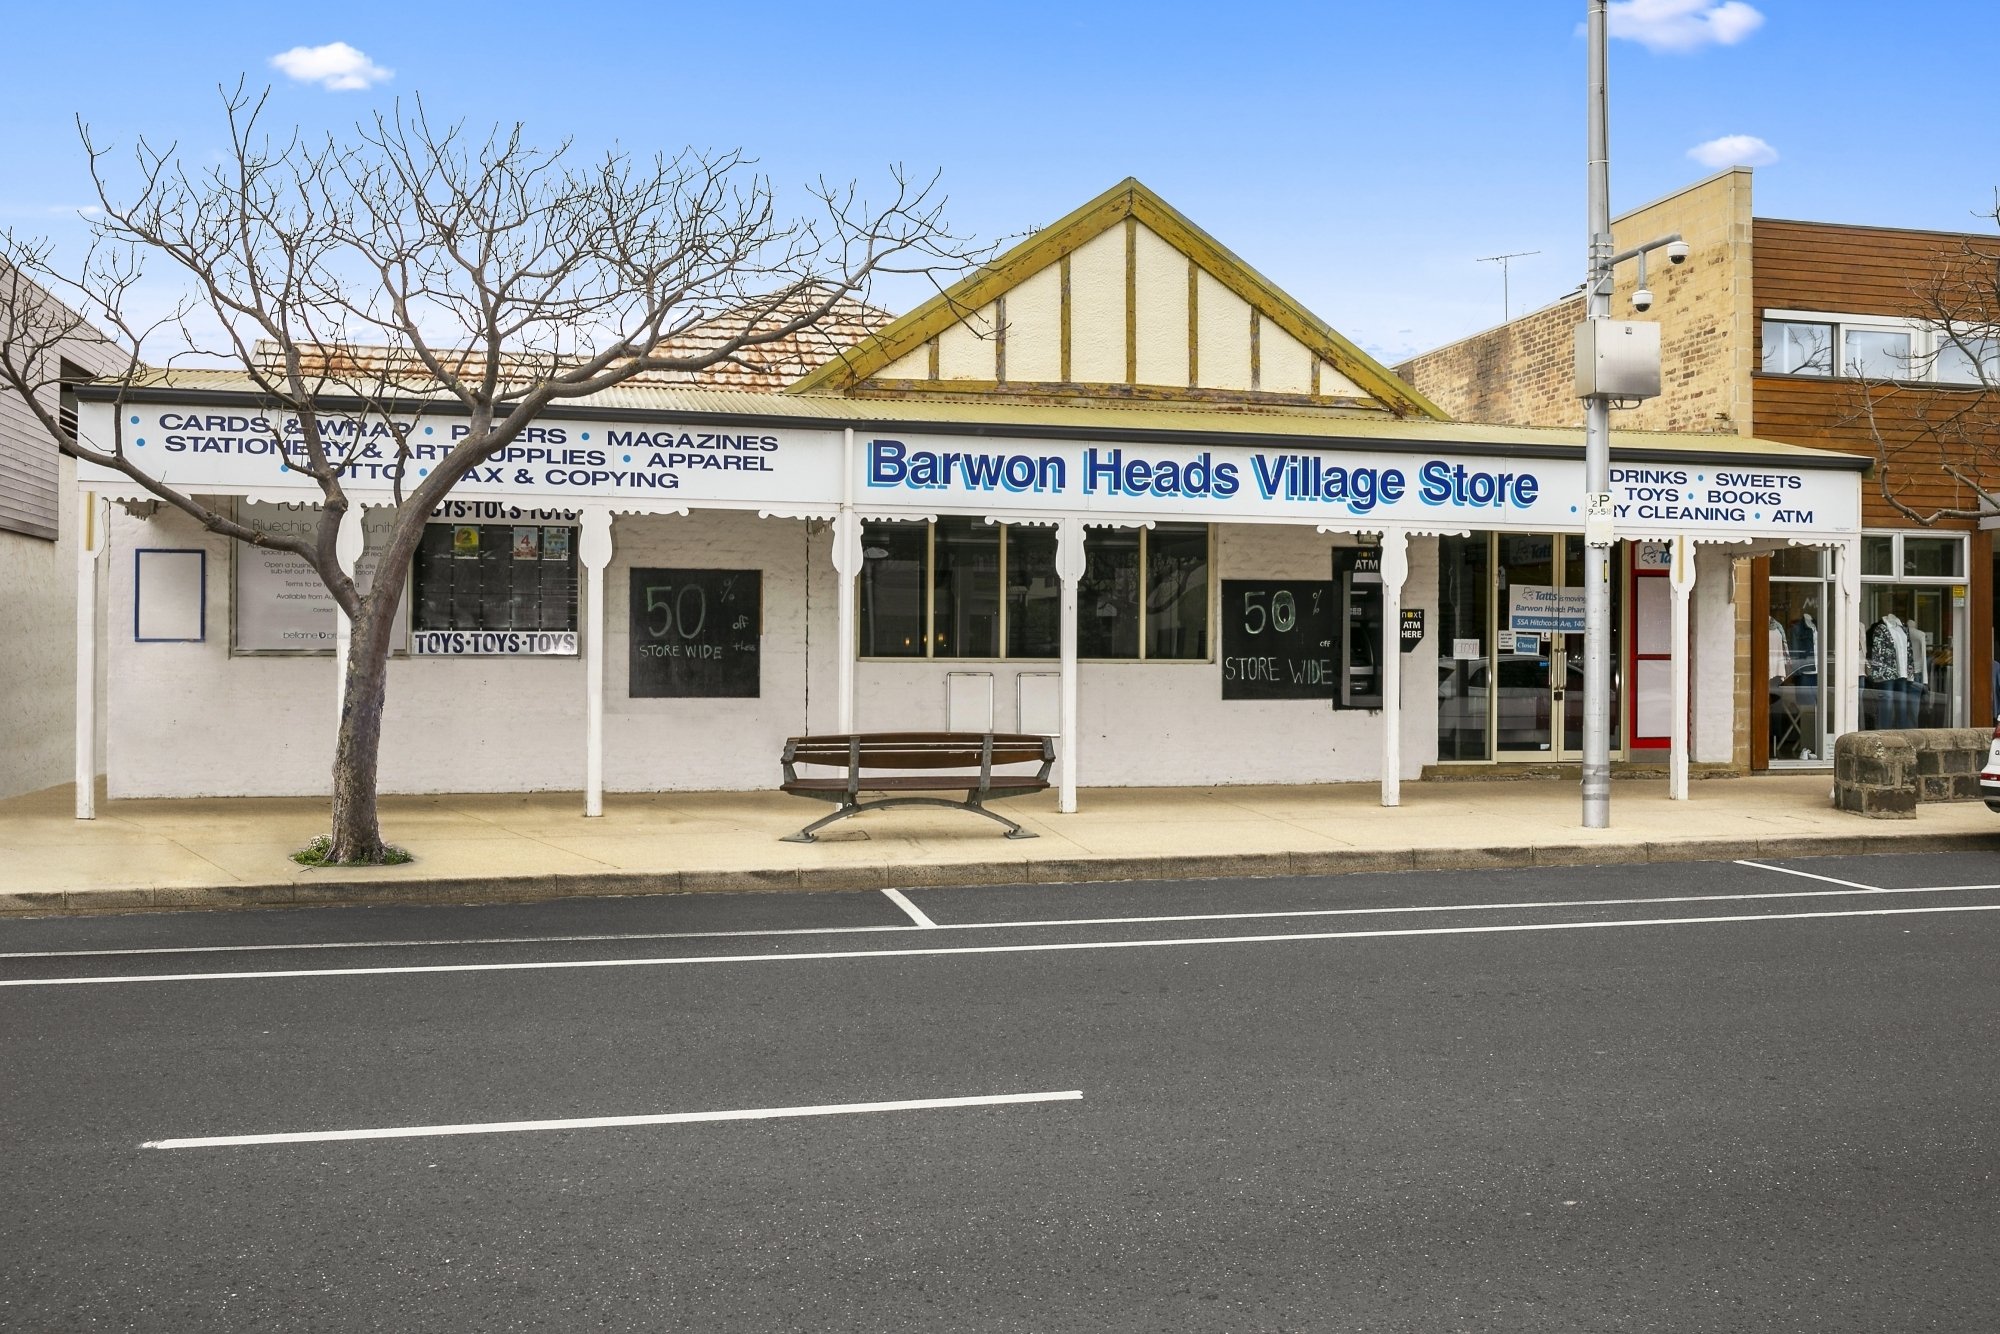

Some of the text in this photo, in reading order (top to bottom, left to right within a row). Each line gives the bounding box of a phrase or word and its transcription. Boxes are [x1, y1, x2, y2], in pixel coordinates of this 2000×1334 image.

[159, 413, 411, 438] CARDS & WRAP
[607, 430, 779, 451] MAGAZINES
[361, 442, 383, 458] &
[393, 443, 455, 461] ART
[486, 447, 606, 466] UPPLIES
[646, 452, 774, 471] APPAREL
[514, 468, 535, 484] &
[545, 469, 679, 489] COPYING
[867, 439, 1539, 515] Barwon Heads Village Store
[1609, 469, 1688, 485] DRINKS
[1715, 472, 1802, 489] SWEETS
[1625, 487, 1679, 502] TOYS
[1707, 490, 1782, 505] BOOKS
[1638, 505, 1746, 522] CLEANING
[1772, 509, 1814, 524] ATM
[252, 518, 312, 534] Bluechip
[1354, 559, 1379, 571] ATM
[1535, 590, 1558, 601] Tatts
[646, 583, 706, 639] 50
[1244, 589, 1297, 635] 50
[1515, 604, 1543, 613] Barwon
[1402, 621, 1421, 629] ATM
[1401, 630, 1423, 639] HERE
[415, 633, 575, 654] TOYS TOYS TOYS
[639, 644, 682, 658] STORE
[685, 644, 723, 660] WIDE
[1517, 641, 1537, 650] Closed
[1225, 656, 1334, 685] STORE WIDE
